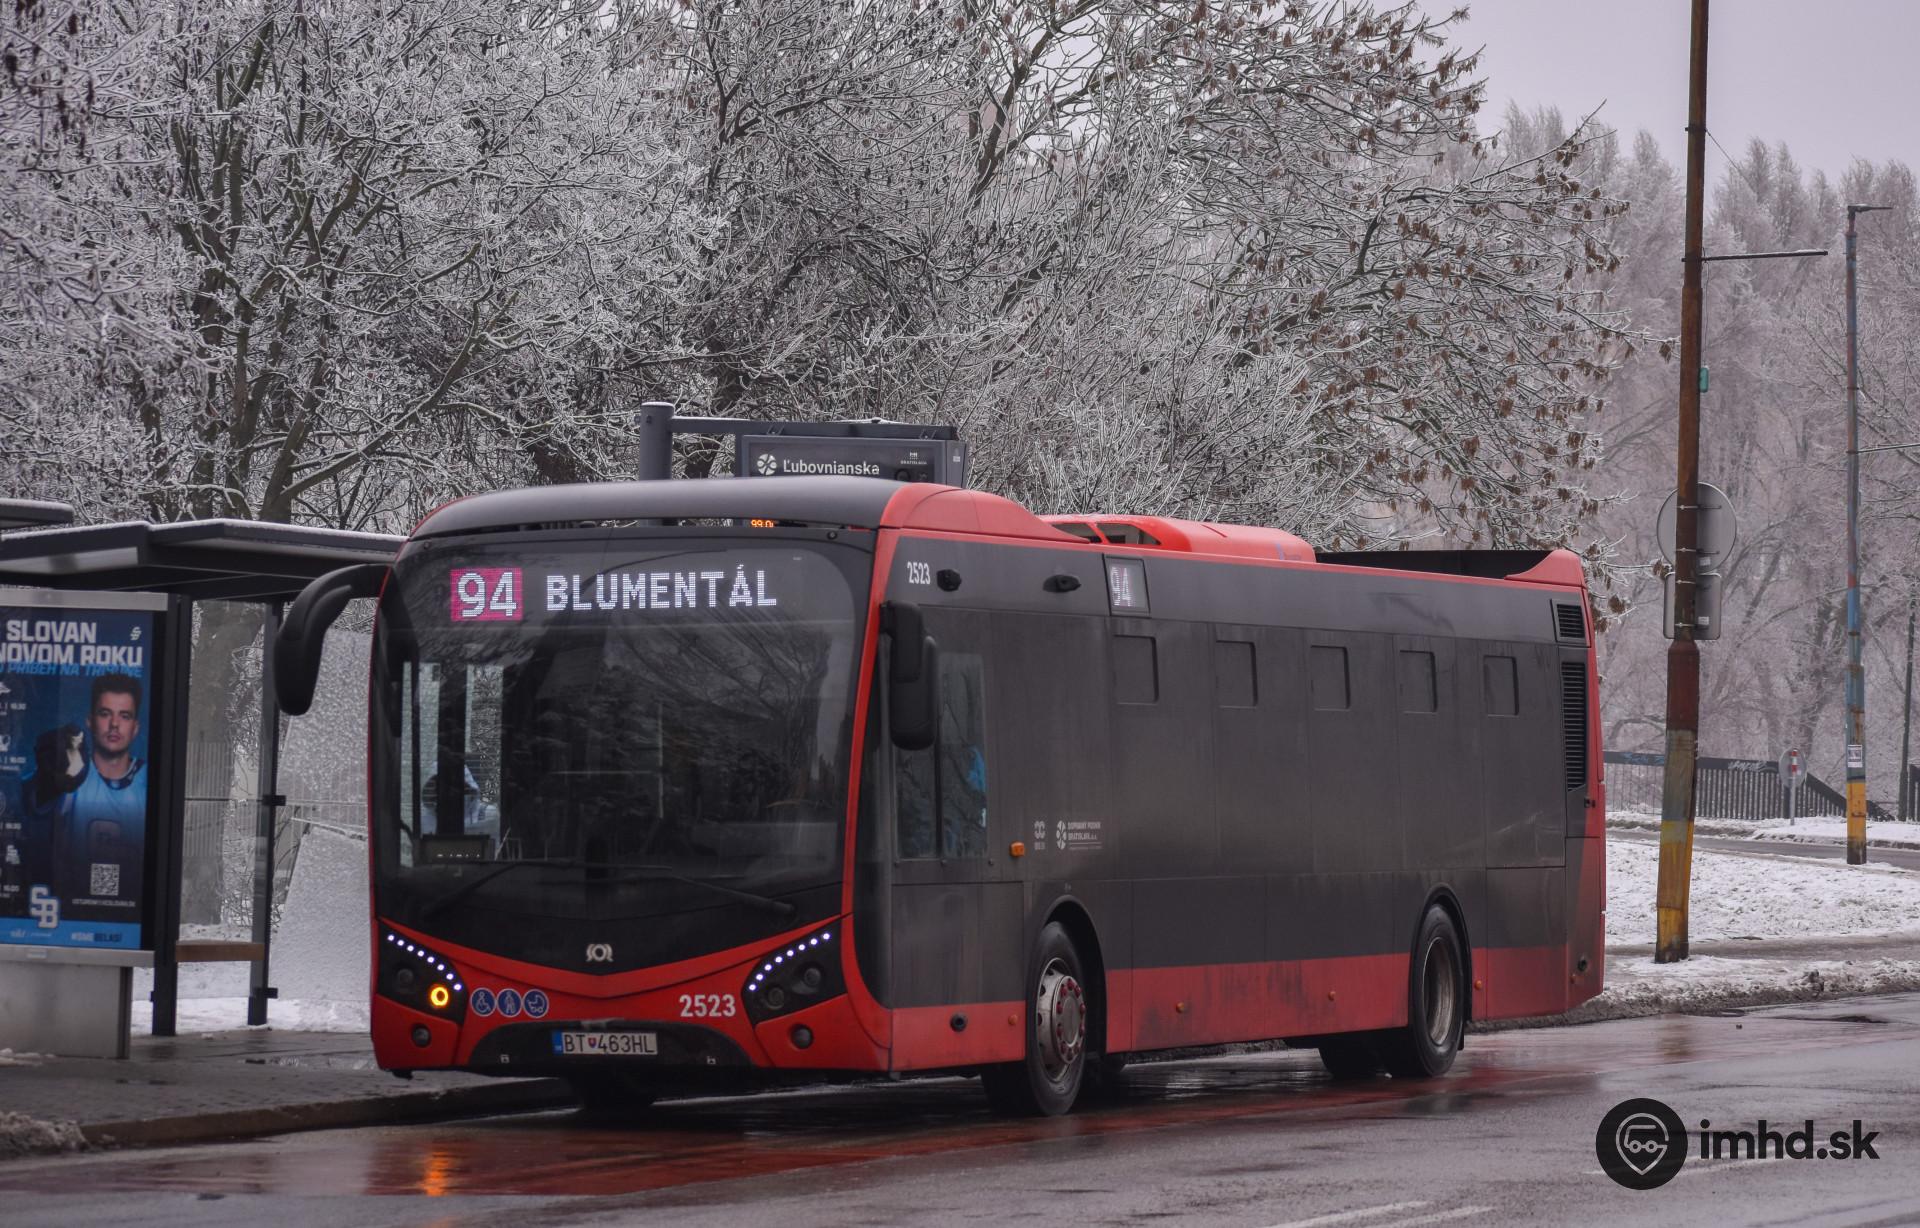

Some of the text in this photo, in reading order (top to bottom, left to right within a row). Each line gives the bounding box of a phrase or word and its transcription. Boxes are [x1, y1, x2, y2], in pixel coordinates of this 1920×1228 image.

[783, 459, 880, 476] Ľubovnianska
[907, 561, 931, 585] 2523
[457, 564, 777, 617] 94 BLUMENTÁL
[1110, 566, 1134, 607] 94
[6, 619, 97, 643] SLOVAN
[81, 645, 143, 667] ROKU
[679, 994, 737, 1018] 2523
